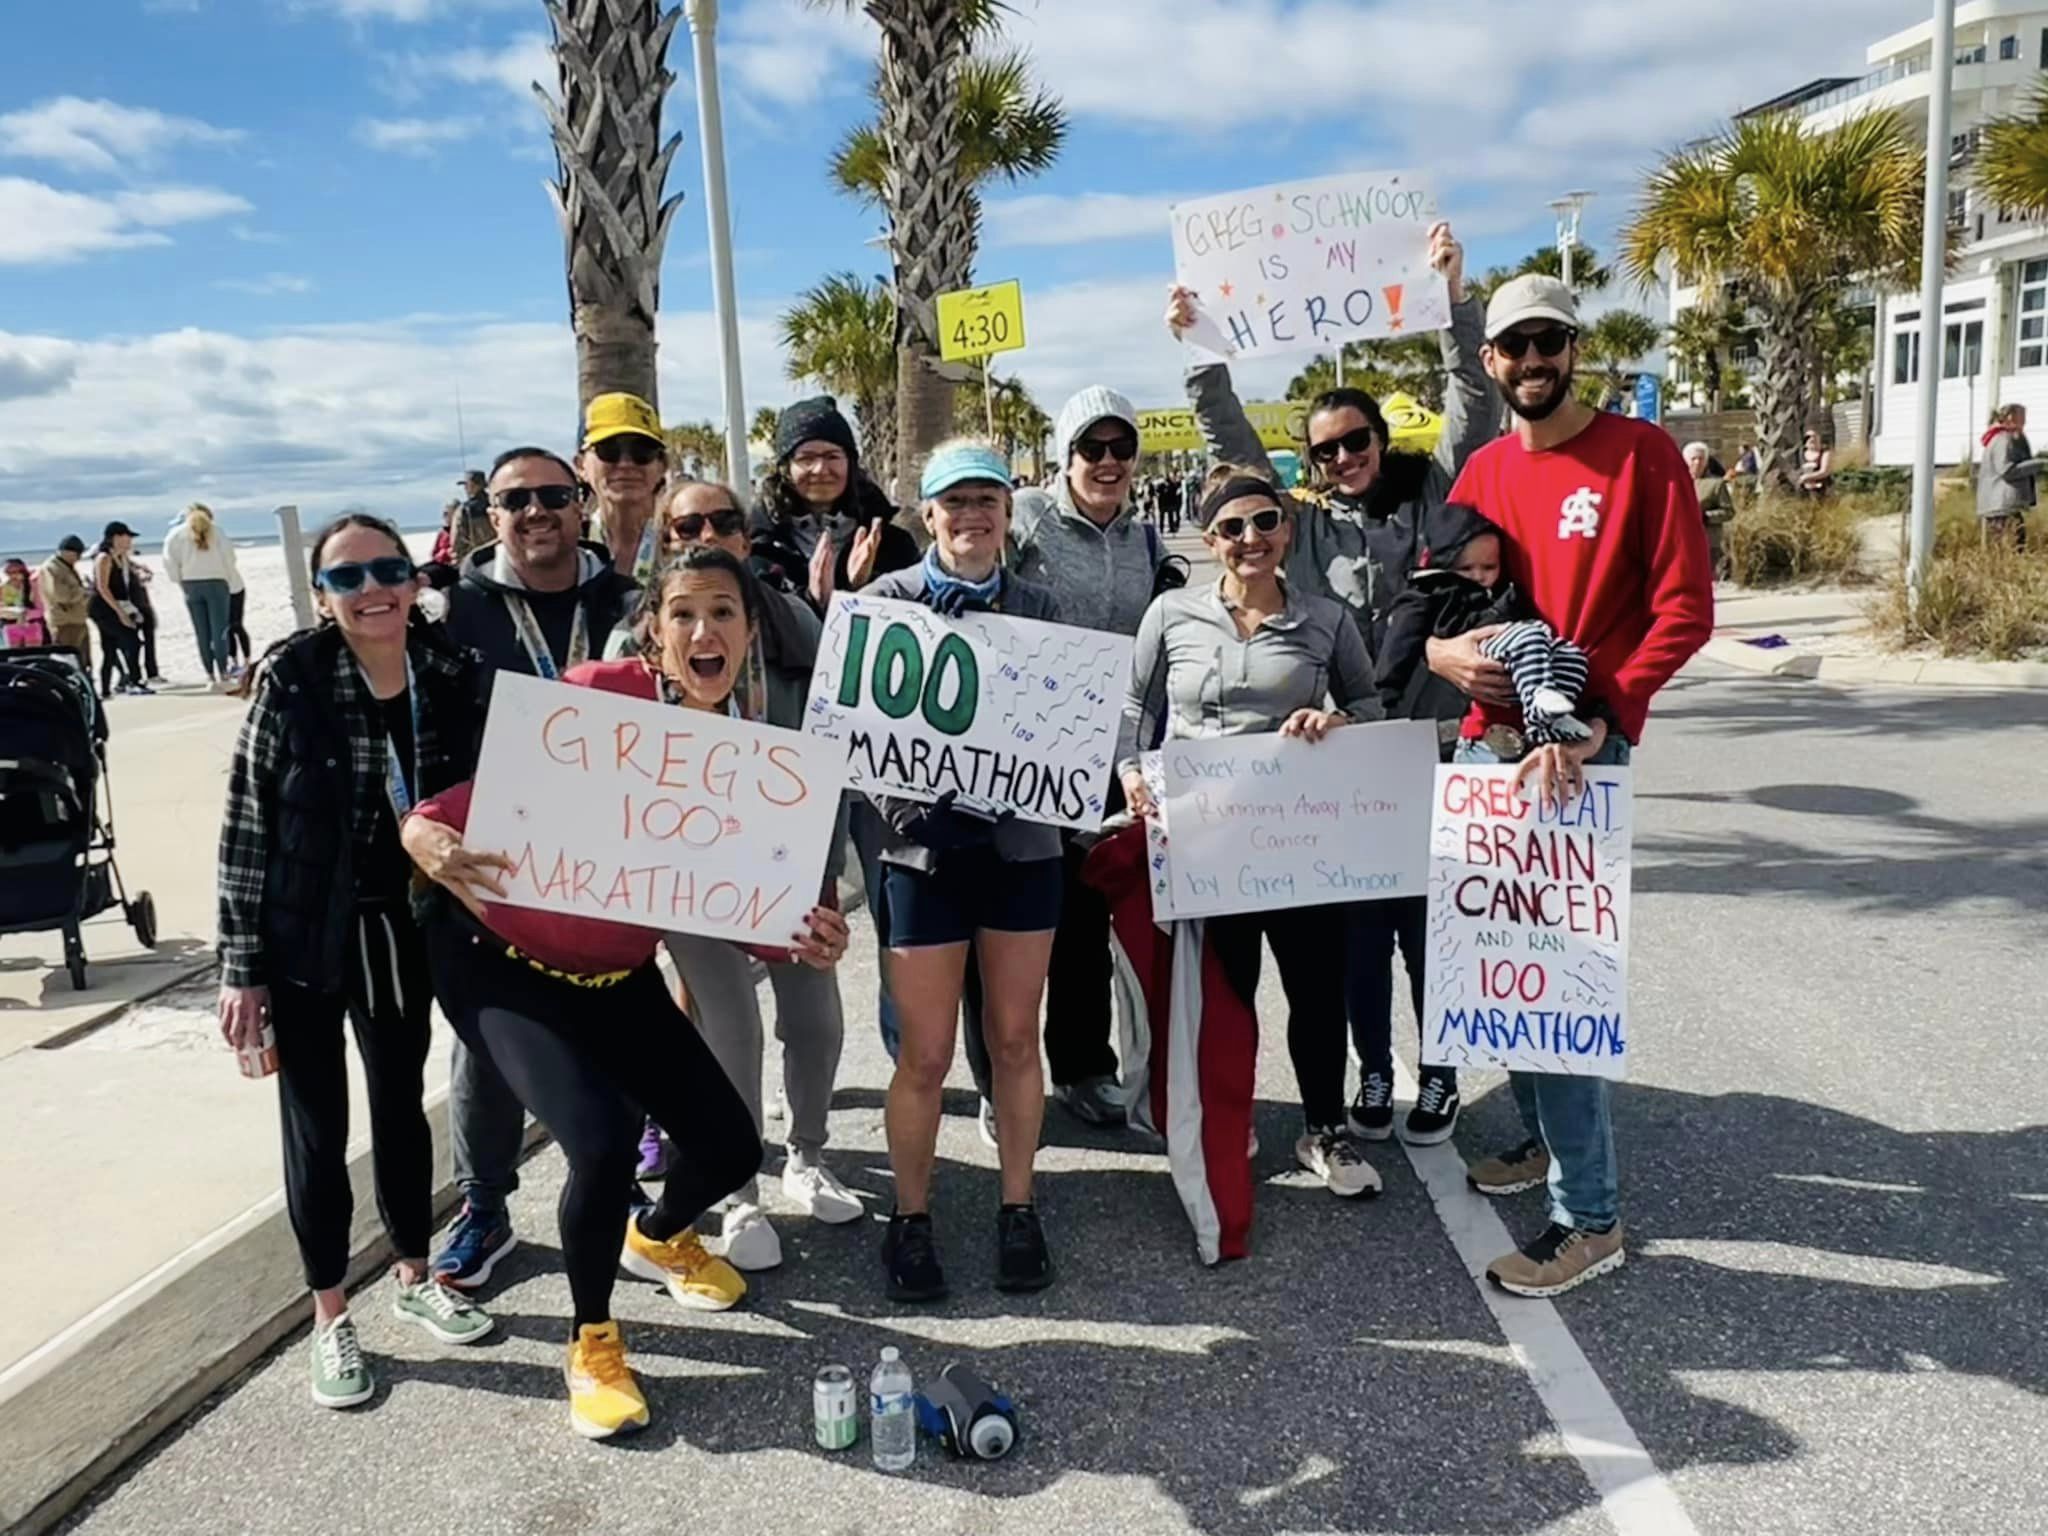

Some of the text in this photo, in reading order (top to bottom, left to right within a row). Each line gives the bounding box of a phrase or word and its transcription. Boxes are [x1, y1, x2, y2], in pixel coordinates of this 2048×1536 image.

[1185, 204, 1263, 256] GREG
[1258, 239, 1356, 280] IS MY
[953, 311, 1008, 349] 4:30
[837, 613, 979, 736] 100
[1011, 722, 1035, 742] 100
[543, 706, 807, 806] GREG'S
[847, 730, 1090, 821] MARATHONS
[1251, 757, 1283, 778] out
[1194, 788, 1399, 823] Running Away from
[1443, 774, 1531, 820] GREG
[1250, 825, 1320, 850] Cancer
[1465, 822, 1596, 884] BRAIN
[497, 842, 793, 929] MARATHON
[1186, 860, 1405, 898] by Greg Schnoor
[1455, 875, 1619, 942] CANCER
[1475, 930, 1566, 952] AND RAN
[1480, 957, 1546, 1002] 100
